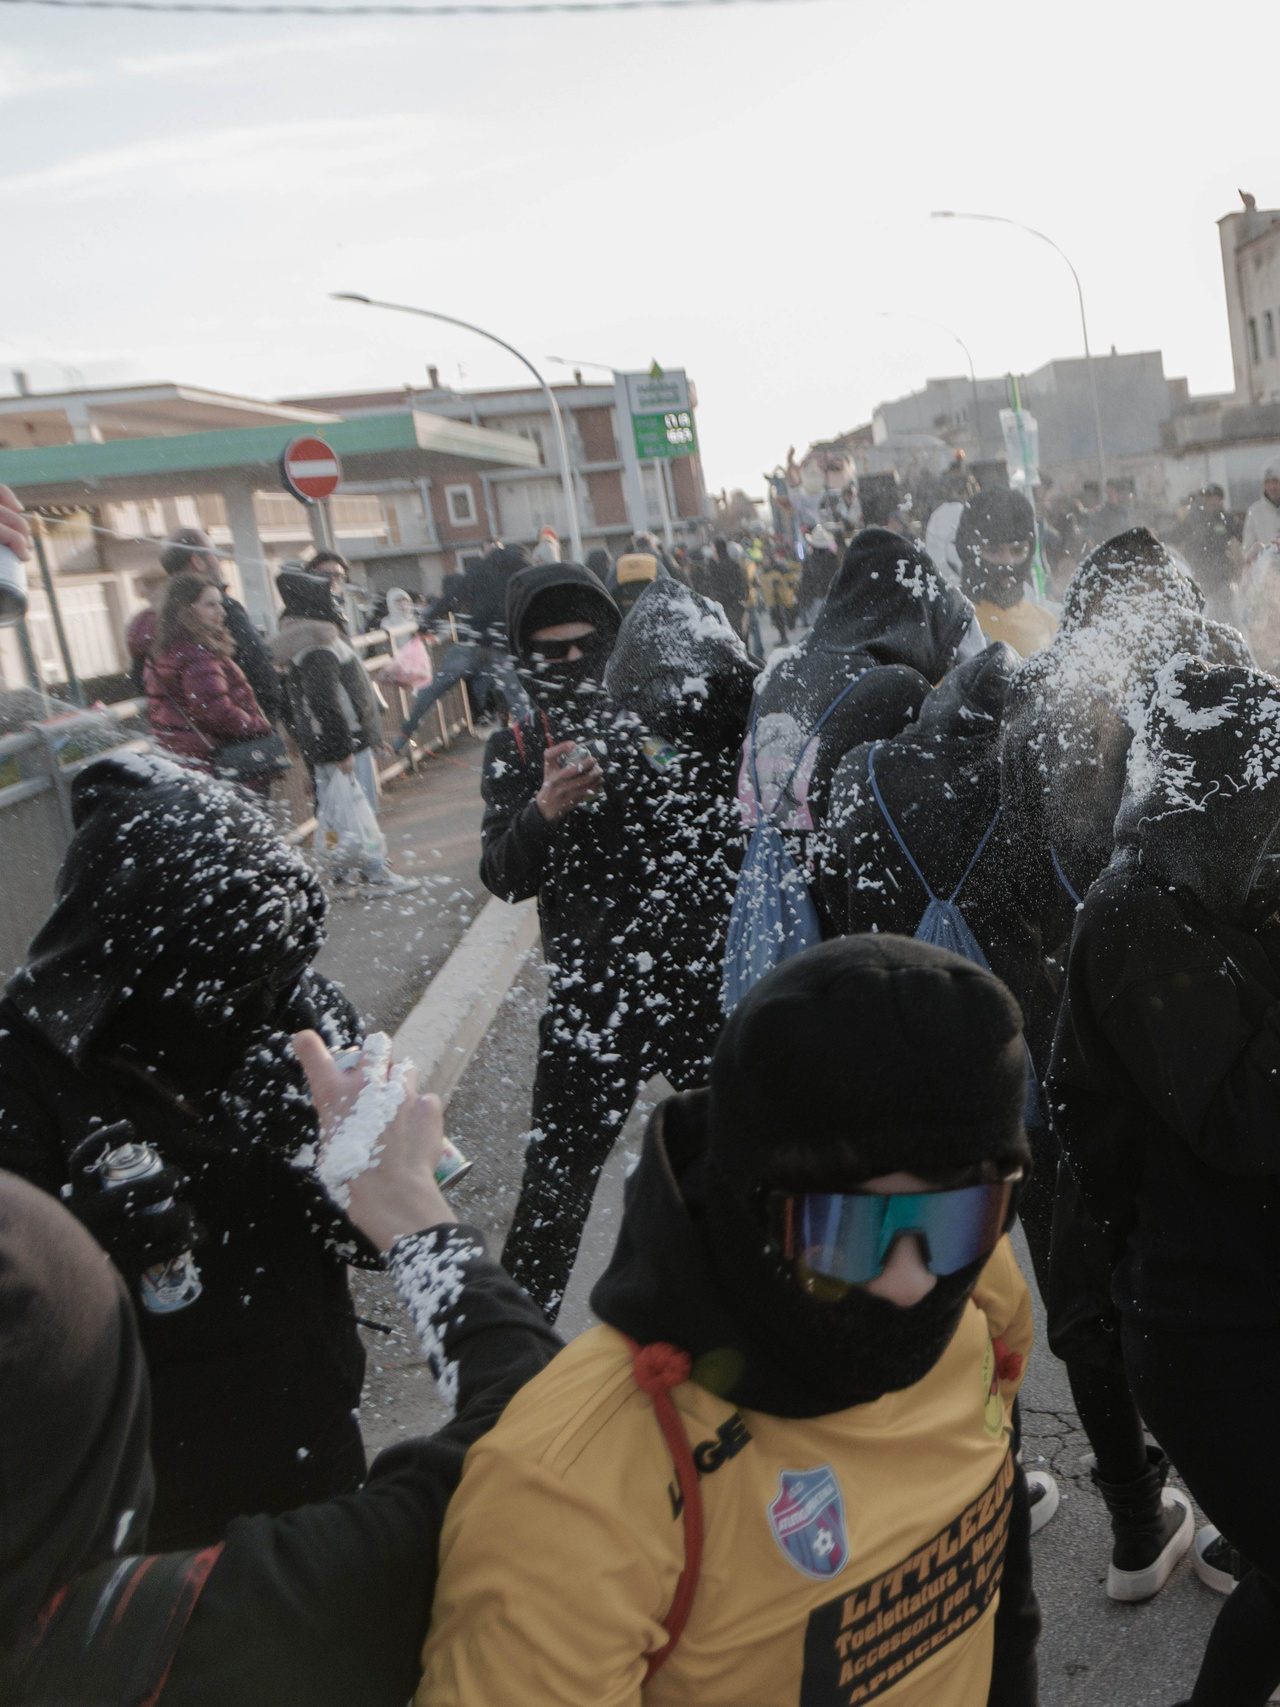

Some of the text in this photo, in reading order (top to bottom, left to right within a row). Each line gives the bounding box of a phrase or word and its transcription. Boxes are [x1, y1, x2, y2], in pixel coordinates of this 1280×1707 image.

[834, 1565, 958, 1659] Toelettatura
[838, 1602, 938, 1688] Accessori
[943, 1578, 973, 1622] per
[848, 1605, 979, 1704] APRICENA
